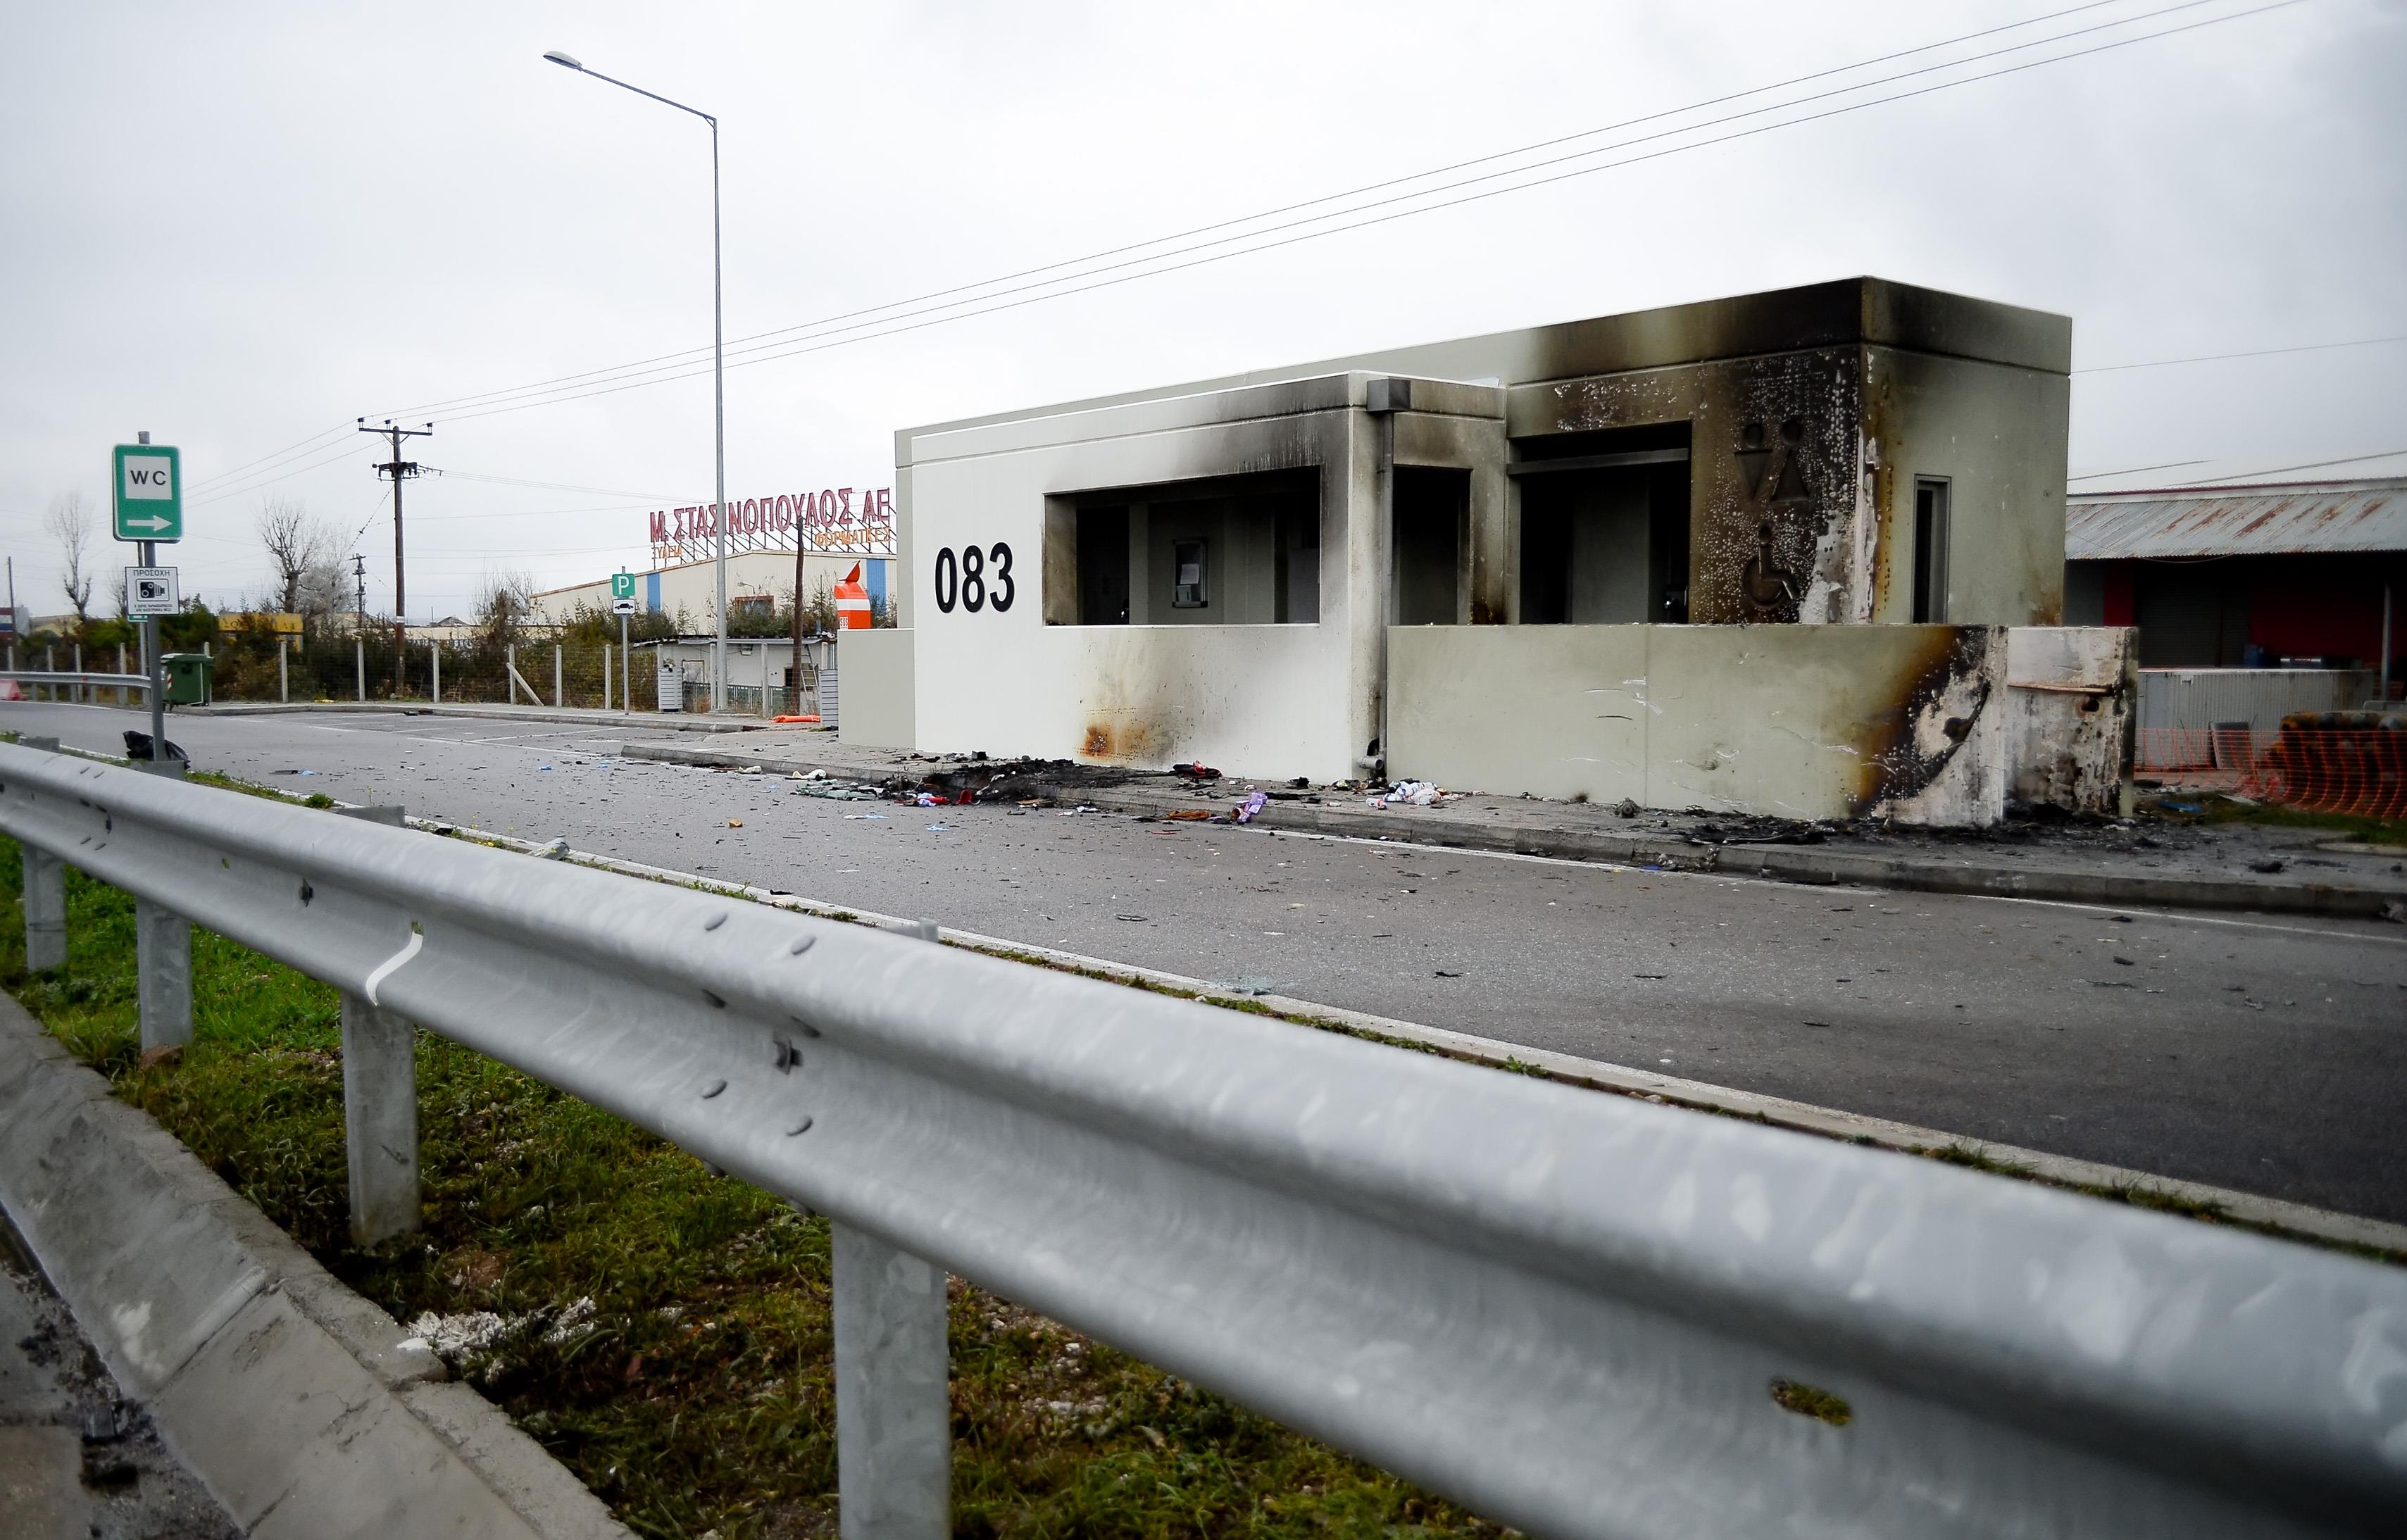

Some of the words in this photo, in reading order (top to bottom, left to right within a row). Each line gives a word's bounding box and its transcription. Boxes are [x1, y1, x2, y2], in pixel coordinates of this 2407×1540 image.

[130, 470, 167, 486] WC
[862, 487, 890, 522] ΑΕ
[618, 576, 630, 595] P
[935, 541, 1015, 613] 083
